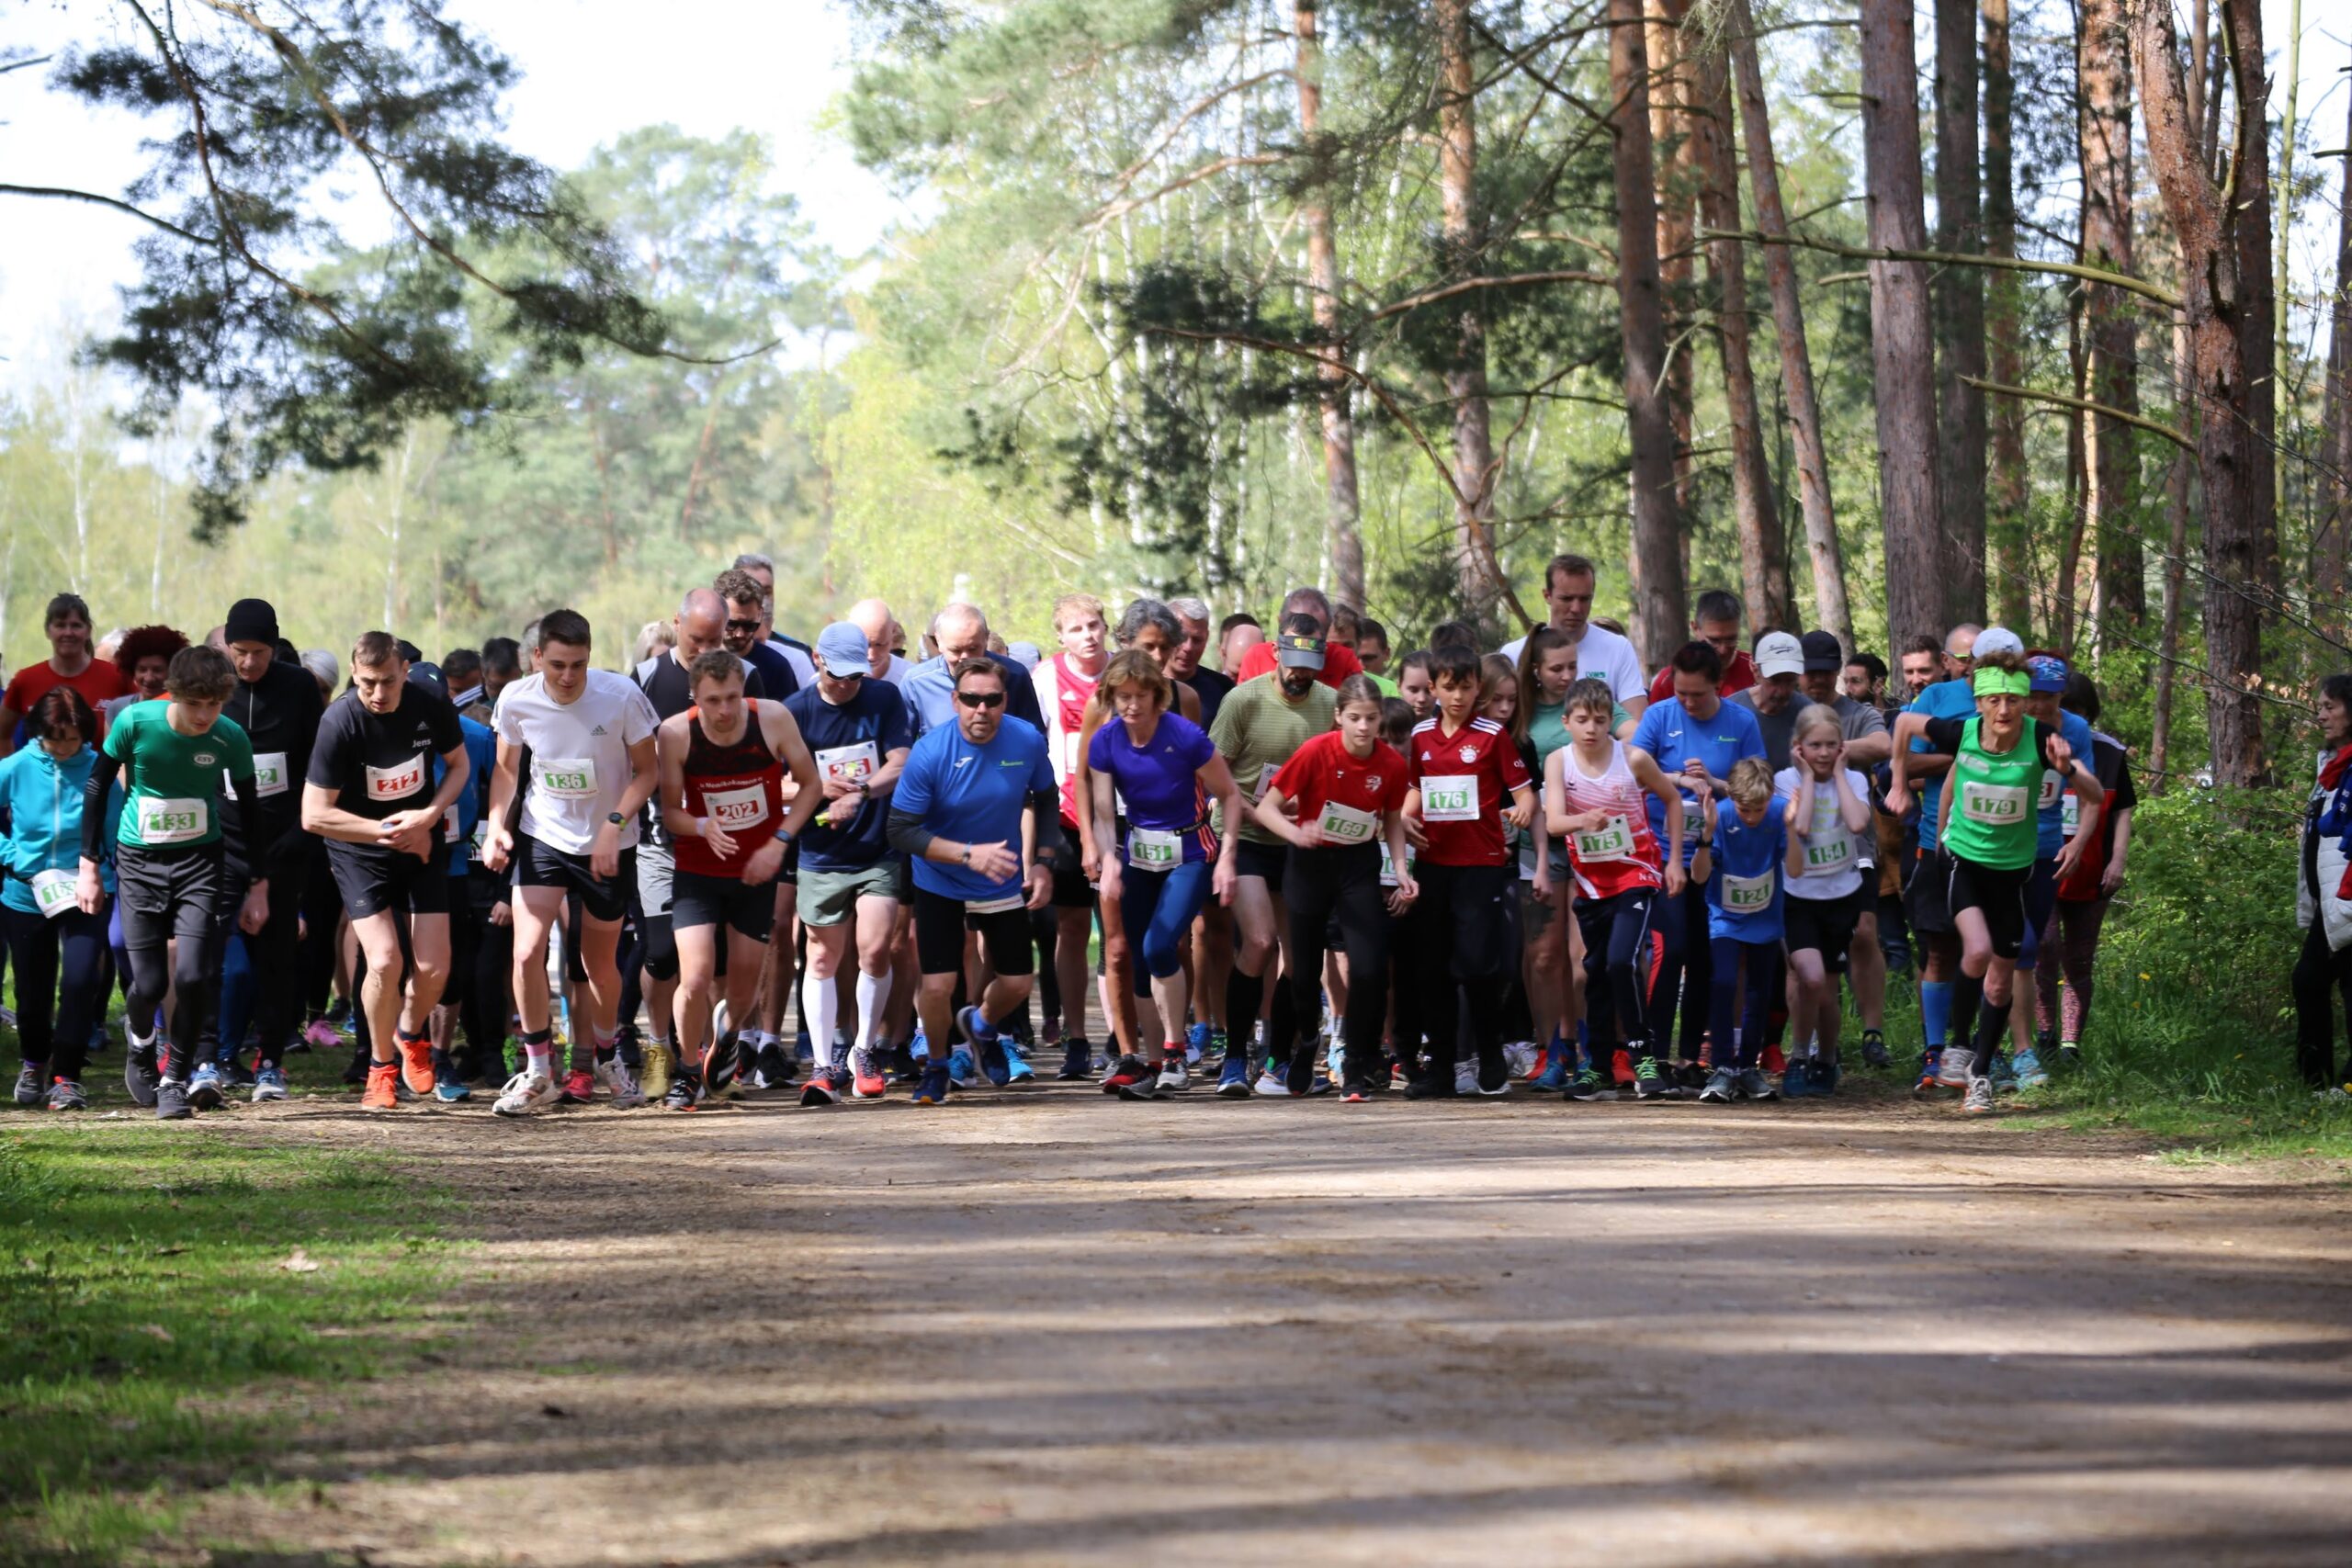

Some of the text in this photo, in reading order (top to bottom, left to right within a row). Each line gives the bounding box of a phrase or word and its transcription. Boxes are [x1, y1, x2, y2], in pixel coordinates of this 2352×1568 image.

[855, 713, 880, 739] N
[412, 739, 432, 749] Jens
[381, 773, 414, 791] 212
[548, 774, 582, 789] 136
[1433, 792, 1464, 808] 176
[1978, 797, 2013, 814] 179
[720, 802, 753, 819] 202
[155, 814, 191, 830] 133
[1330, 818, 1363, 836] 169
[1585, 833, 1617, 852] 175
[1138, 843, 1168, 861] 151
[1814, 843, 1843, 863] 154
[48, 881, 77, 901] 163
[1737, 886, 1767, 904] 124
